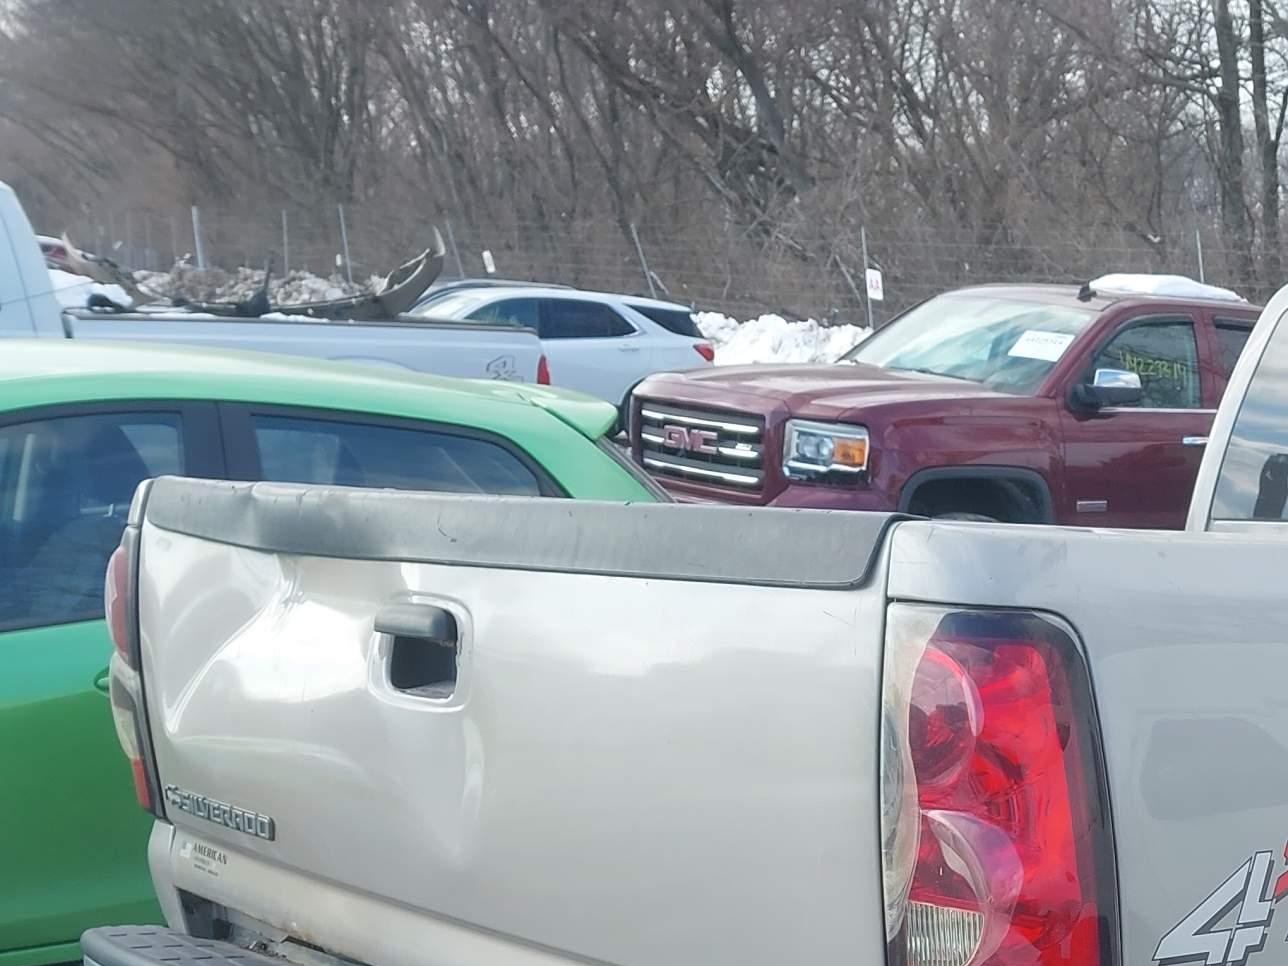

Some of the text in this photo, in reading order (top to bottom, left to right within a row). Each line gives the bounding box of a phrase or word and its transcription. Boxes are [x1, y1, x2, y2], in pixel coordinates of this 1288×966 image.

[663, 424, 718, 455] GMC
[178, 792, 271, 839] SILVERADO
[193, 843, 227, 865] AMERICAN
